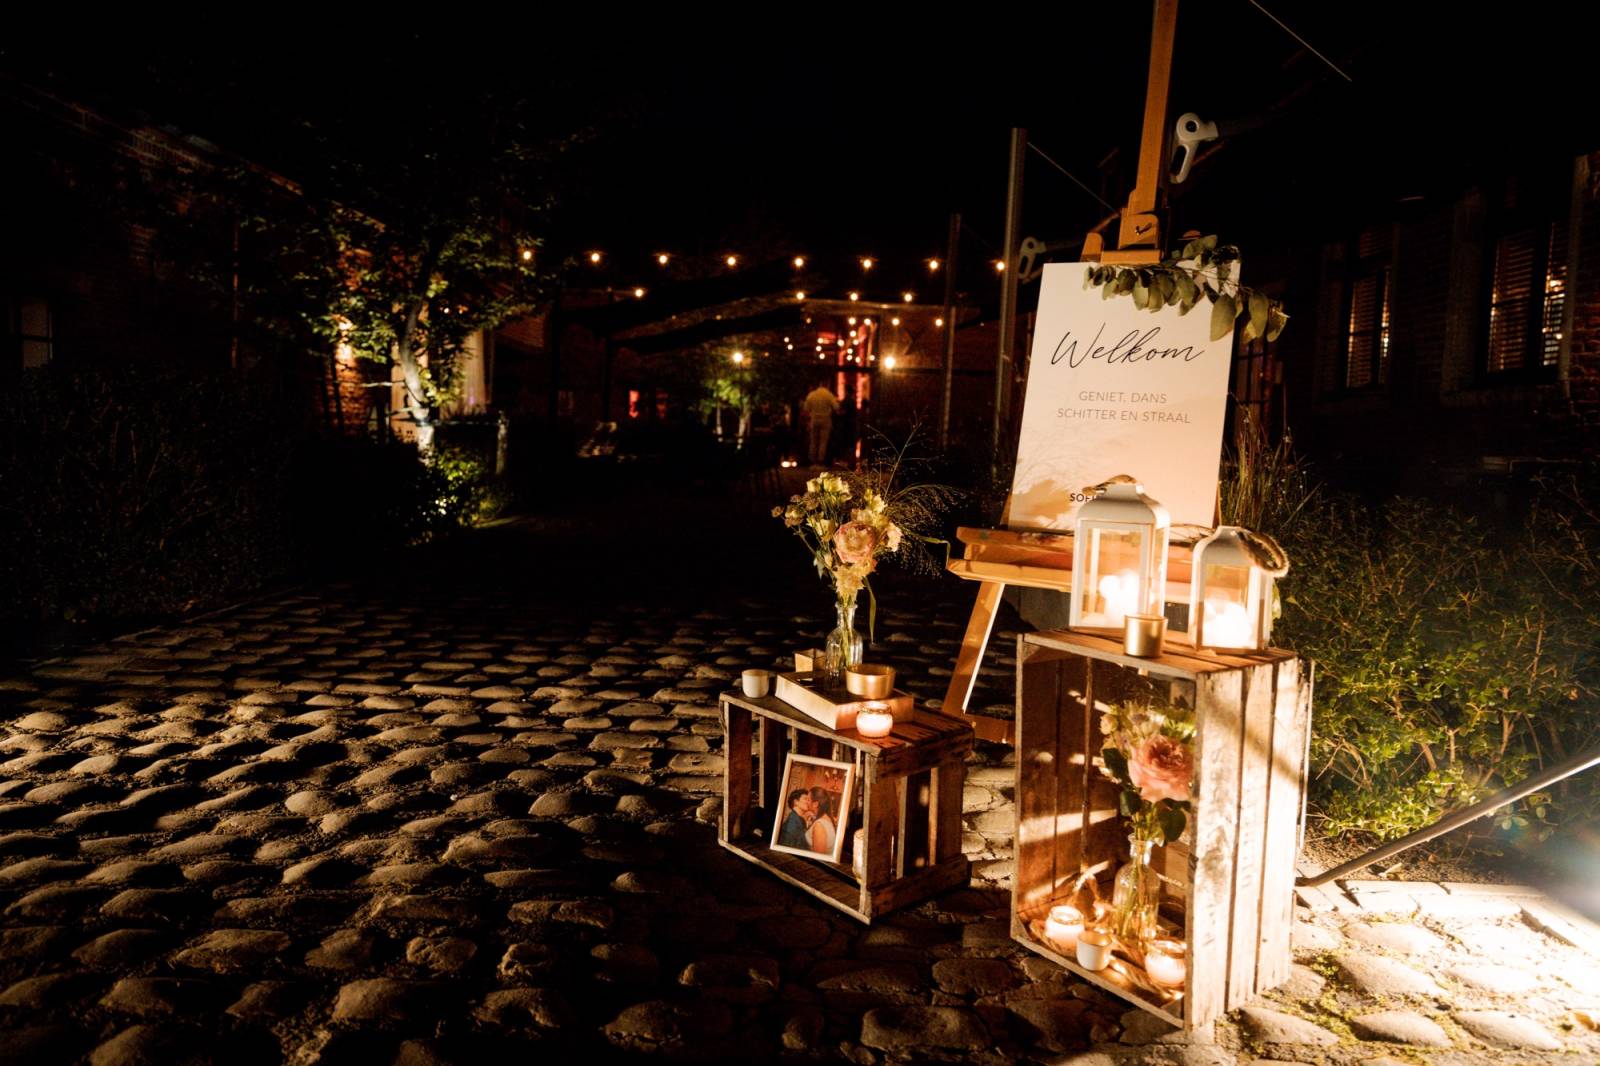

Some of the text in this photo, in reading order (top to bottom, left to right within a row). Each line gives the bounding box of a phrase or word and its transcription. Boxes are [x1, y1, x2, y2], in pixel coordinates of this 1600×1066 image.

[1050, 322, 1206, 369] Welkom
[1130, 391, 1168, 404] DANS
[1056, 408, 1192, 424] SCHITTER EN STRAAL
